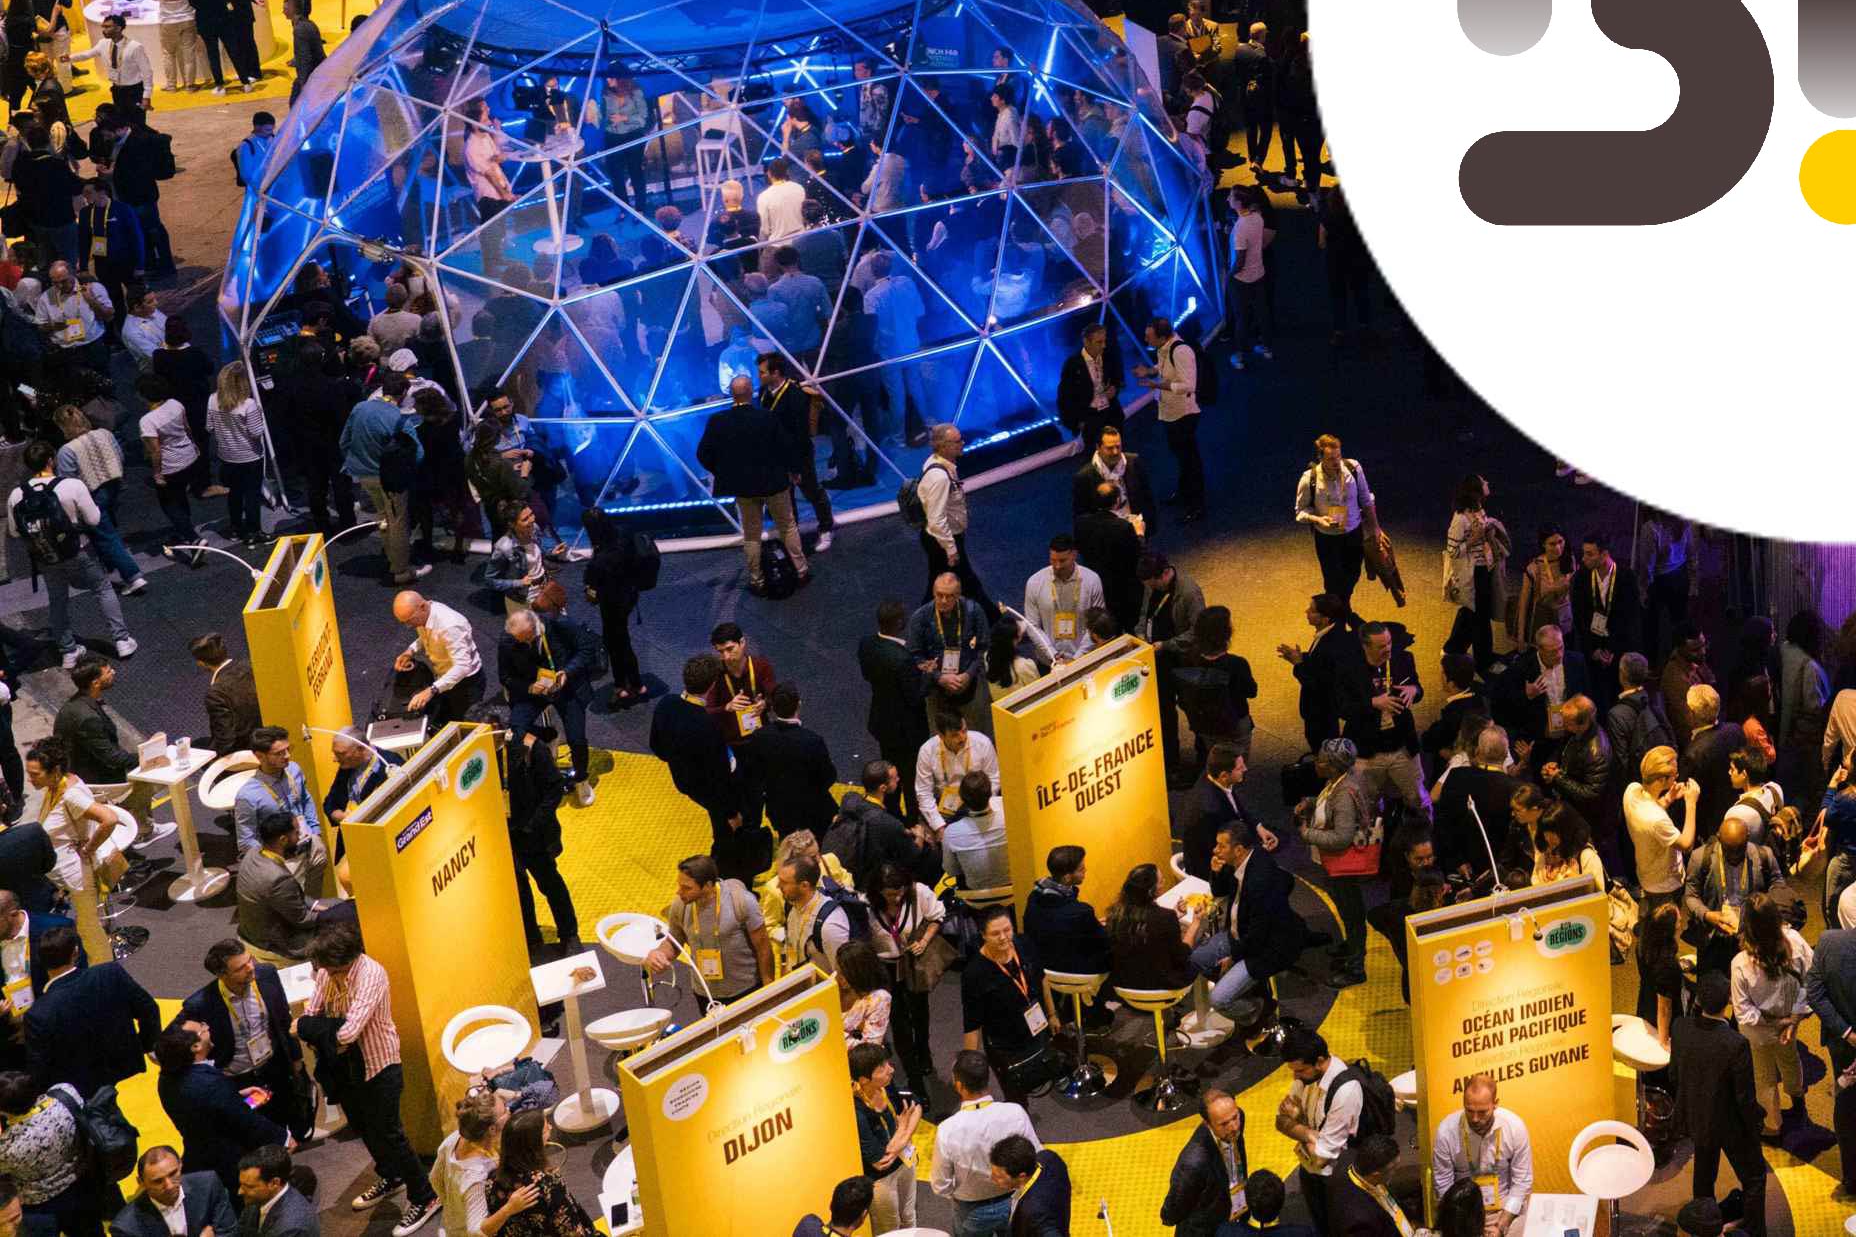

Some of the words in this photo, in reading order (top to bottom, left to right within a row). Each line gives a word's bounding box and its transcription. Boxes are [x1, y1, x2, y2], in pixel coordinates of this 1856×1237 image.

[1036, 728, 1154, 810] ÎLE-DE-FRANCE
[1075, 770, 1122, 812] OUEST
[431, 835, 476, 897] NANCY
[1550, 927, 1585, 946] RÉGIONS
[1452, 1030, 1504, 1058] OCÉAN
[1509, 1008, 1587, 1043] PACIFIQUE
[1462, 1007, 1514, 1035] OCÉAN
[1520, 991, 1575, 1021] INDIEN
[1529, 1043, 1589, 1074] GUYANE
[723, 1107, 793, 1166] DIJON
